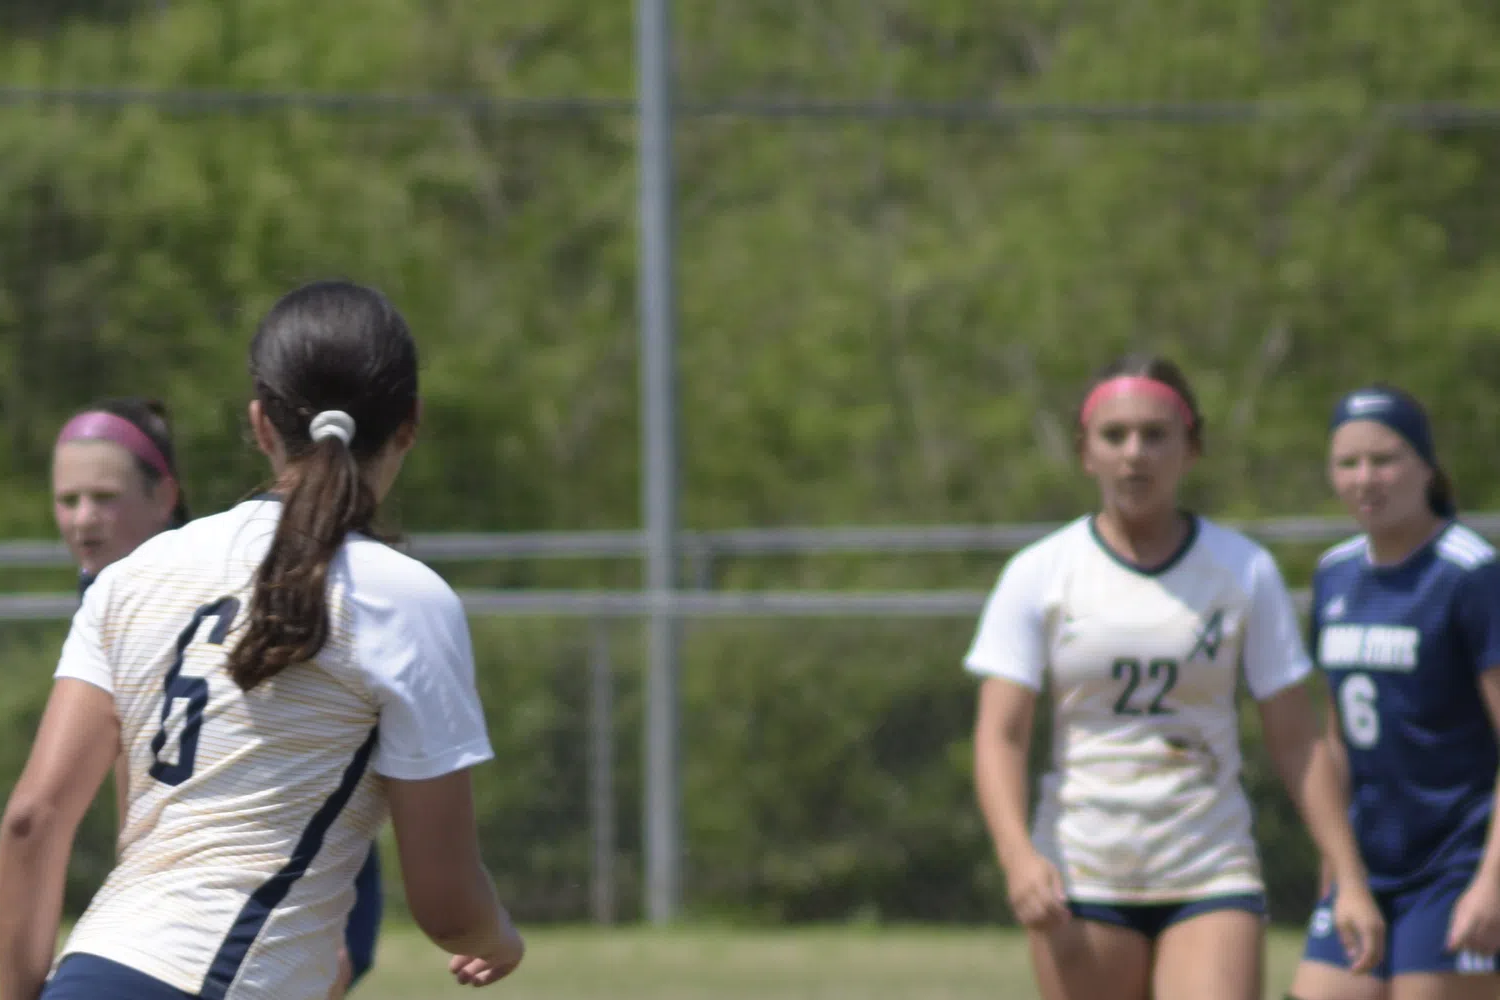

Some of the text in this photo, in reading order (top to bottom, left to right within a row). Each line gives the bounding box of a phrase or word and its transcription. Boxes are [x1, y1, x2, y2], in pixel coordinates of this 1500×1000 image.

[148, 594, 241, 787] 6
[1111, 656, 1181, 716] 22
[1339, 671, 1379, 749] 6
